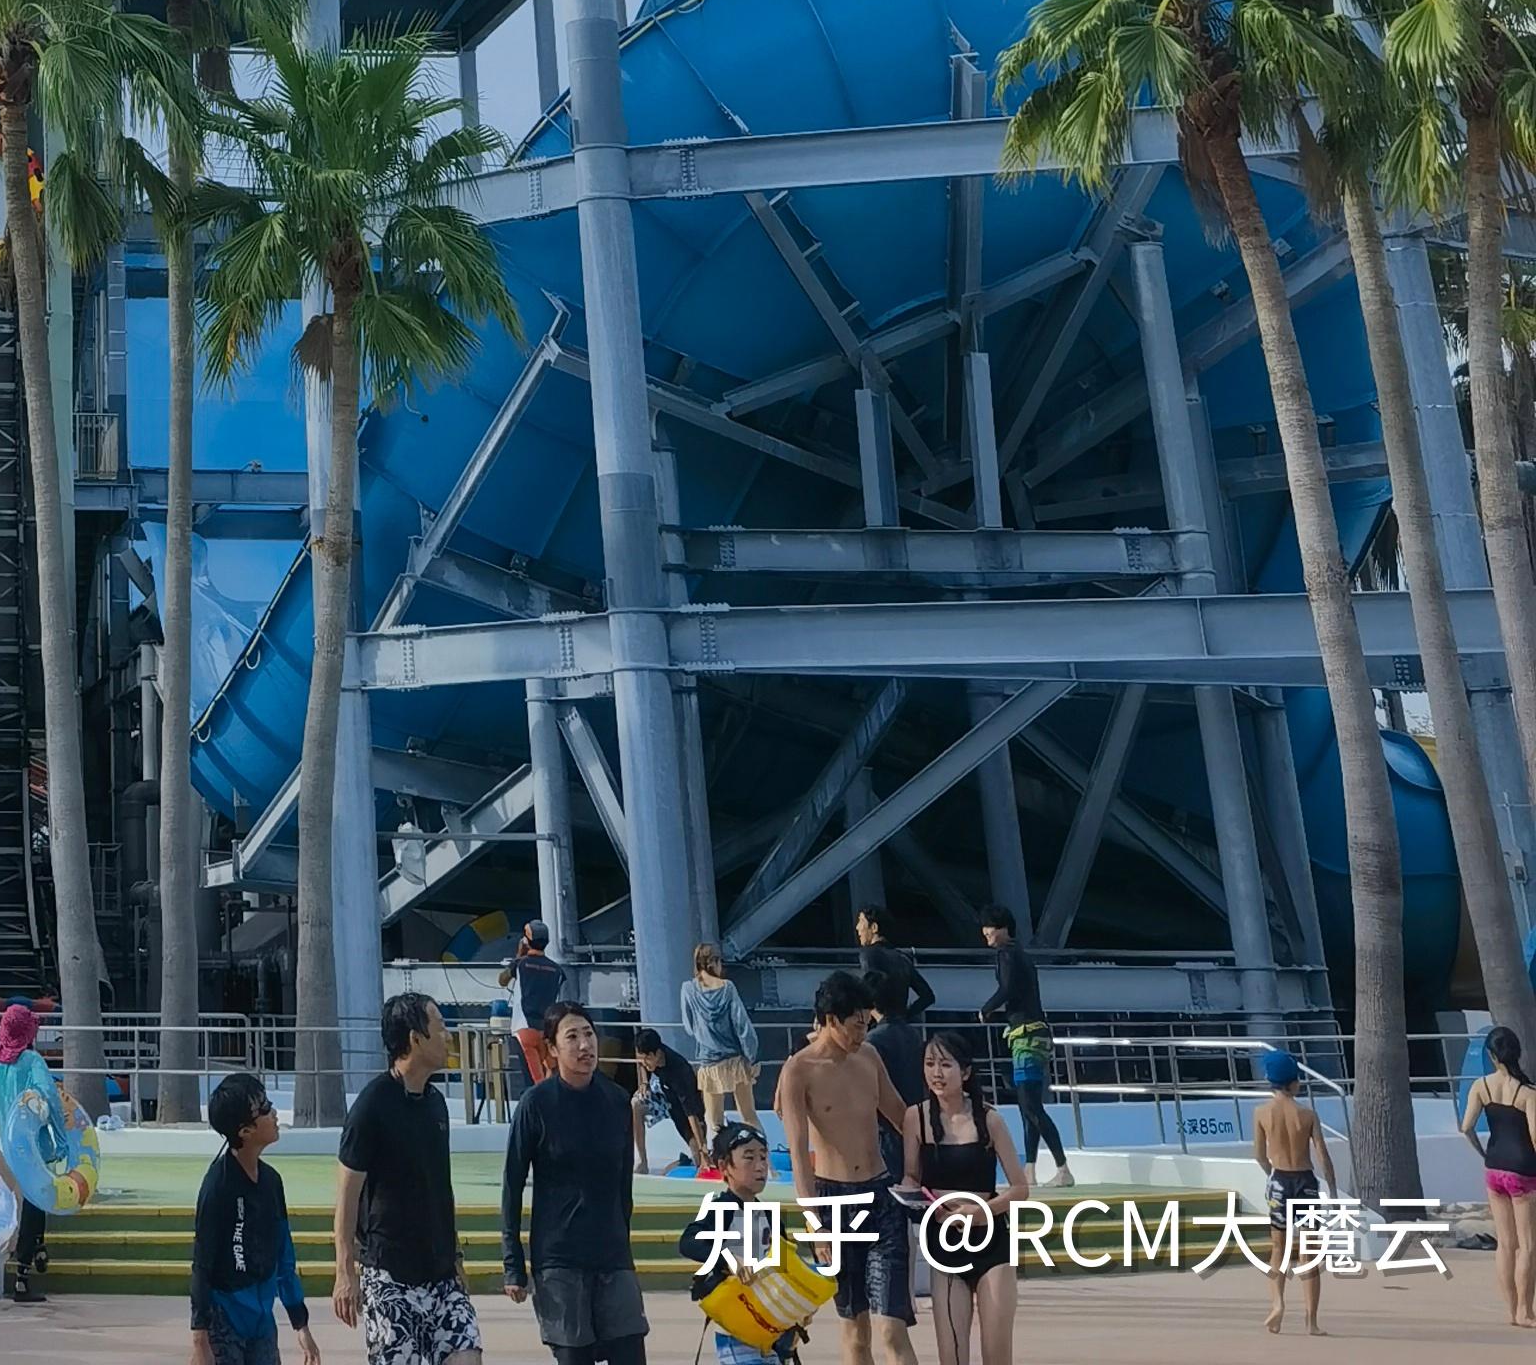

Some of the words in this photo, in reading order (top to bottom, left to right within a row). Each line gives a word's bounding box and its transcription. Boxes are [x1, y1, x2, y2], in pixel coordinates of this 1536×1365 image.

[1176, 1117, 1234, 1135] 水深85cm
[232, 1222, 244, 1243] THE
[233, 1244, 246, 1272] GAME
